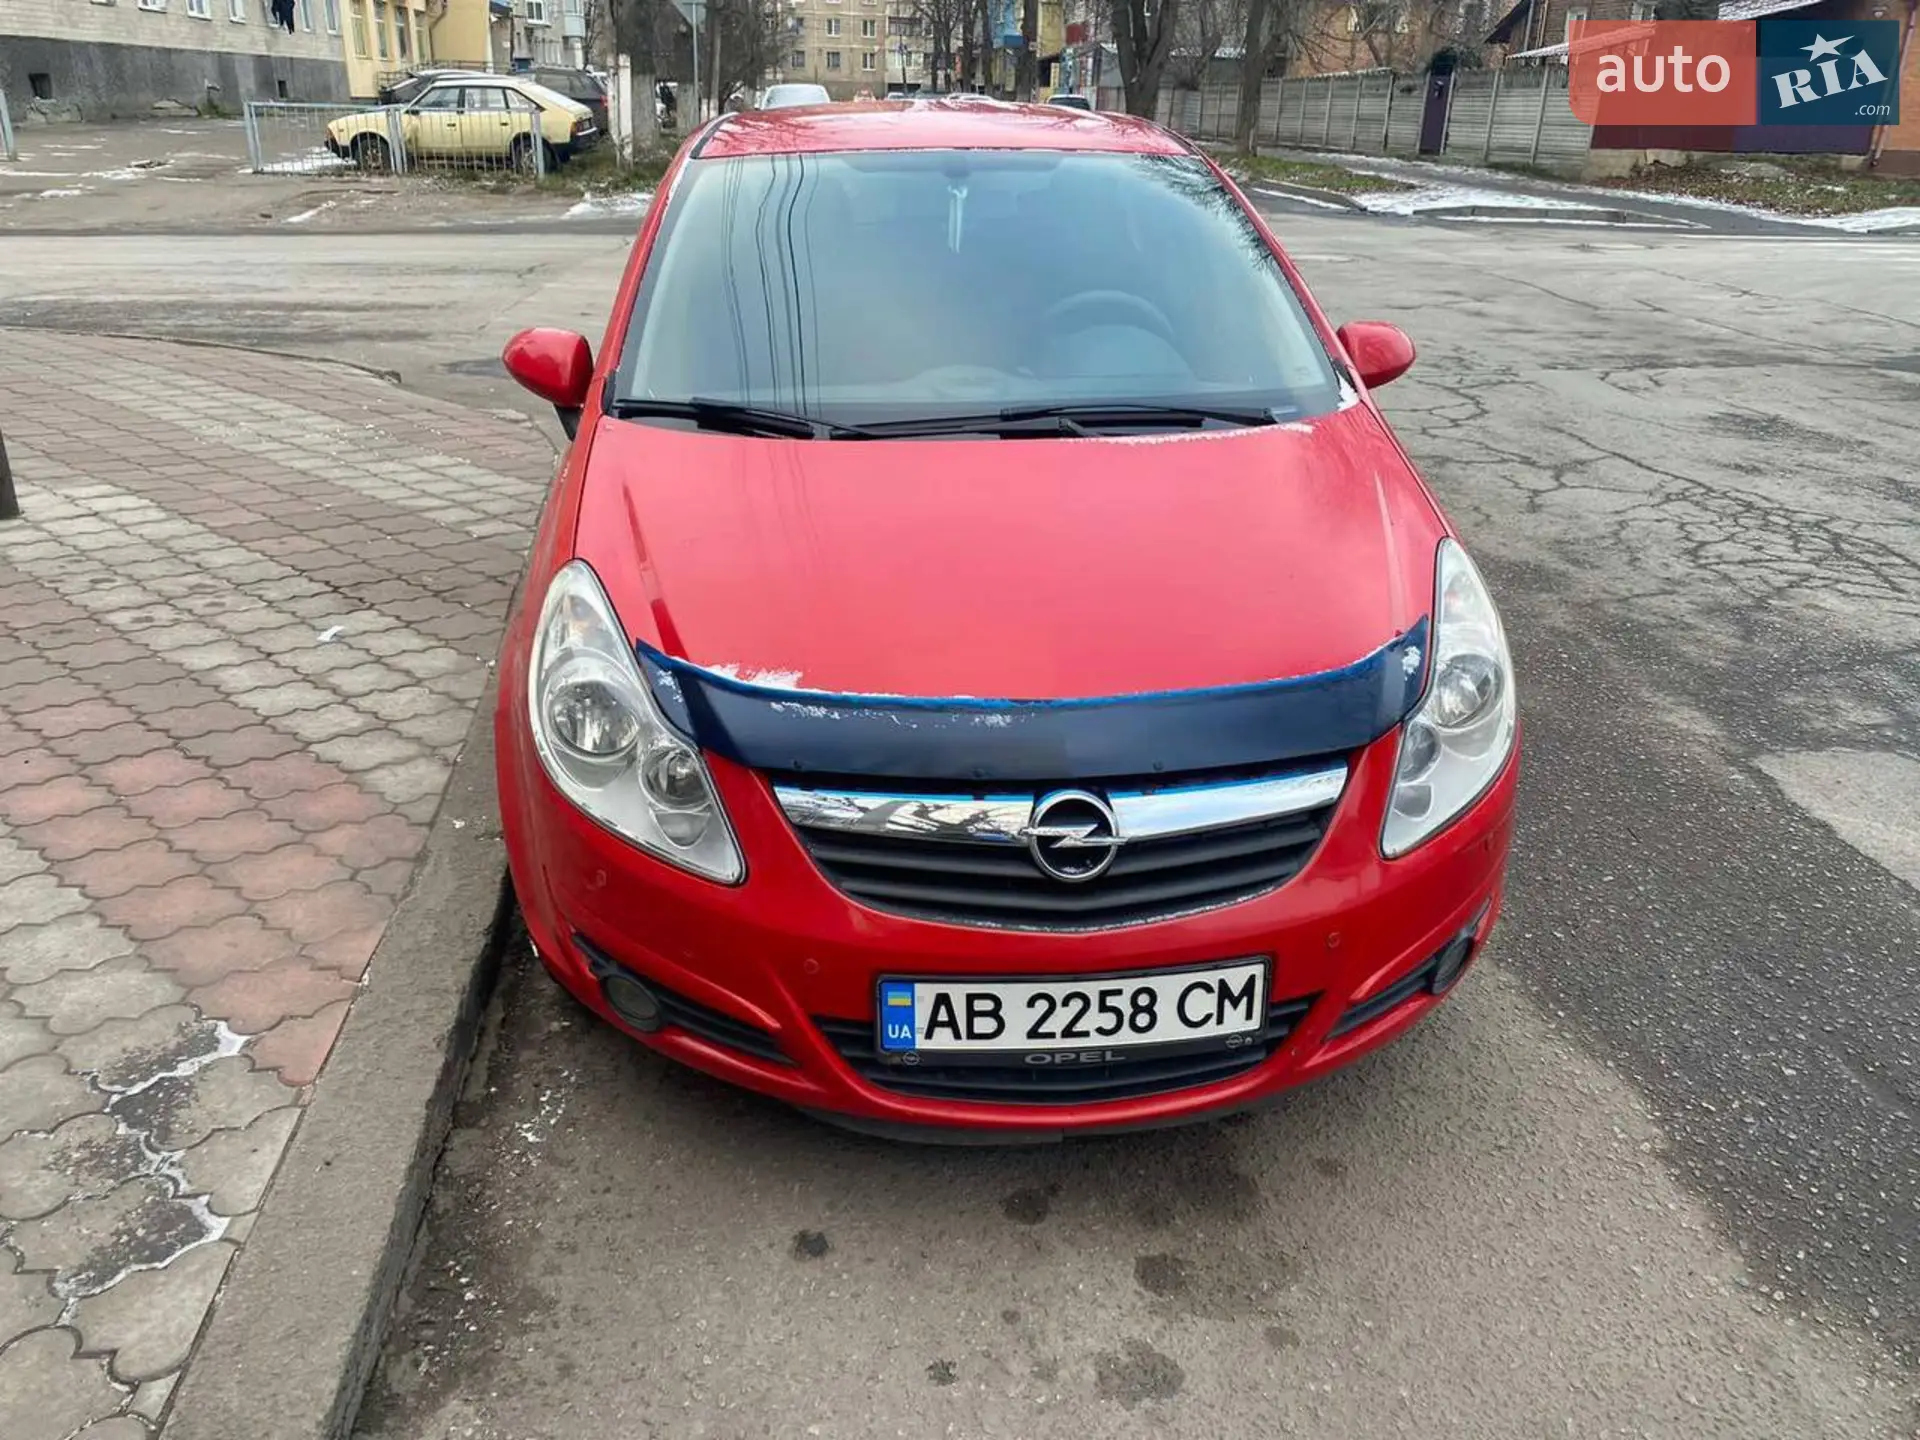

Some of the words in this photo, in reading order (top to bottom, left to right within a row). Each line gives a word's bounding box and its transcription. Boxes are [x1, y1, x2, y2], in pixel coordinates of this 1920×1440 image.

[924, 992, 1006, 1040] AB
[1026, 986, 1157, 1039] 2258
[1176, 974, 1256, 1029] CM
[887, 1024, 913, 1040] UA
[1024, 1050, 1125, 1065] OPEL
